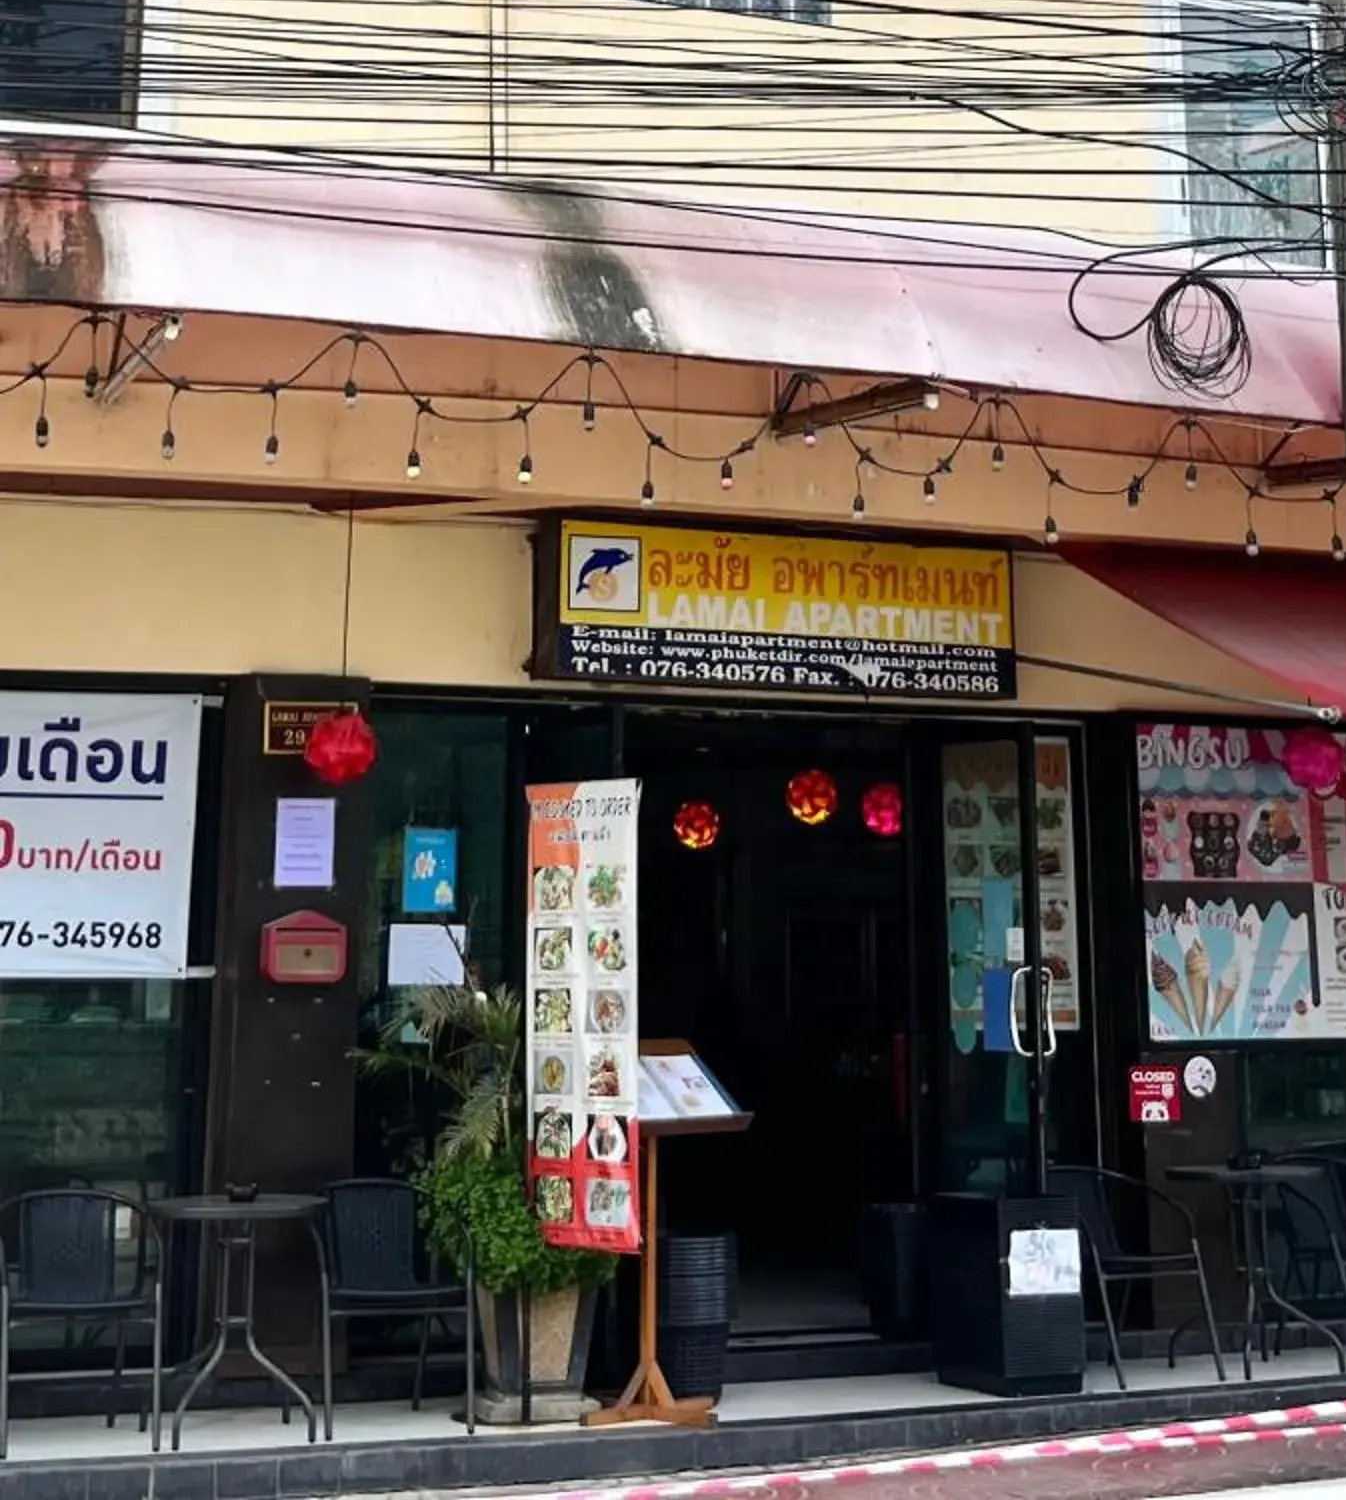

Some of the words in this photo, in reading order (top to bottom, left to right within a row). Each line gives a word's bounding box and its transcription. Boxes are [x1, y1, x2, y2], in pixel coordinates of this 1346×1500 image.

[647, 592, 767, 635] LAMAI
[781, 599, 1004, 647] APARTMENT
[571, 625, 657, 641] E-mail:
[664, 628, 997, 659] lamaiapartment@hotmail.com
[571, 640, 655, 656] Website:
[640, 659, 786, 685] 076-340576
[792, 666, 840, 687] Fax.
[864, 670, 1000, 694] 076-340586
[0, 716, 168, 785] เดือน
[1136, 733, 1249, 770] BINGSU
[1131, 1071, 1175, 1083] CLOSED
